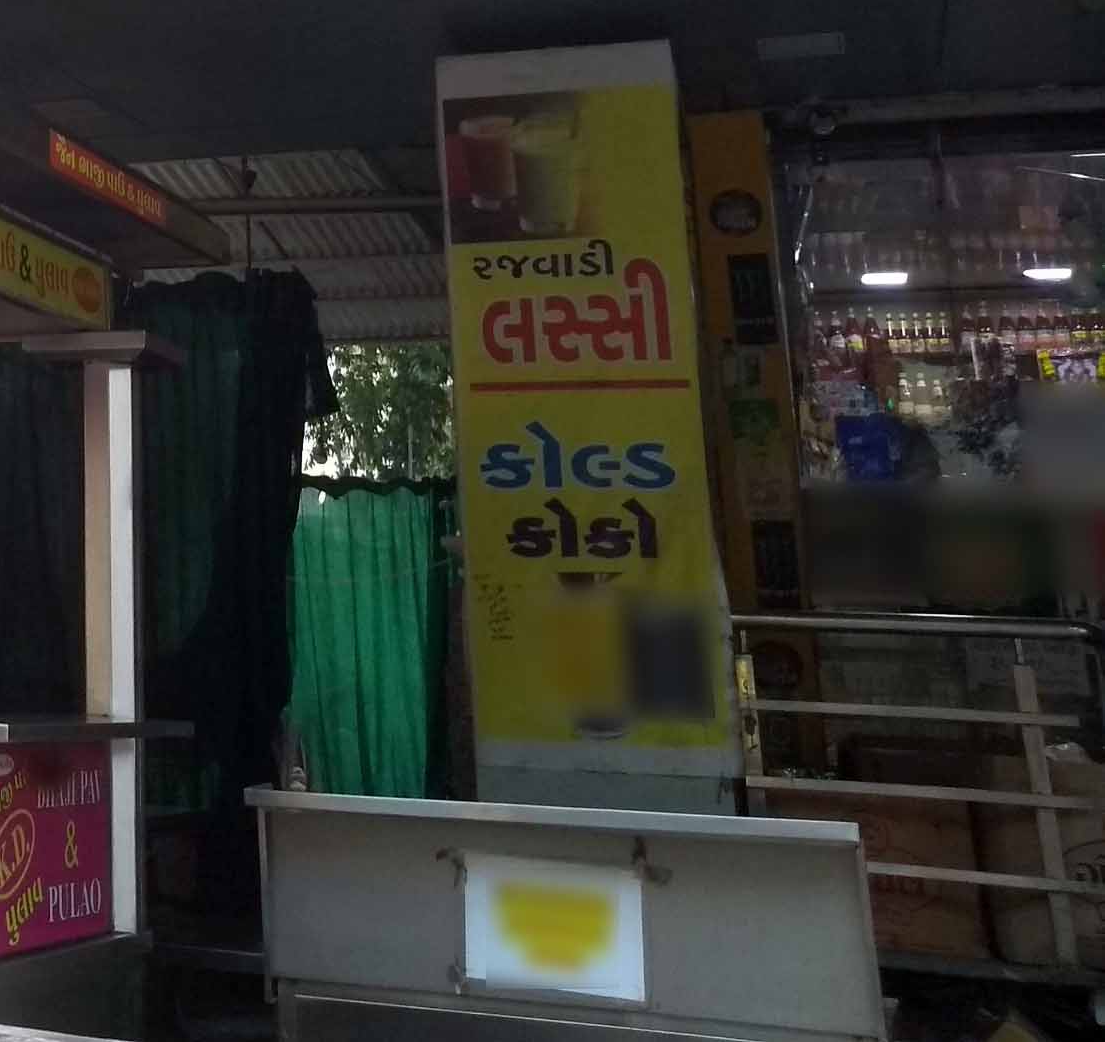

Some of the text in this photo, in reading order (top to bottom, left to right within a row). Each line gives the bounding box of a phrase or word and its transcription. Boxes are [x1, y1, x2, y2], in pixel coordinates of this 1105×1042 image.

[19, 244, 32, 283] &
[473, 239, 614, 279] રજવાડી
[482, 258, 672, 363] લસ્સી
[480, 420, 676, 489] કોલ્ડ
[505, 497, 658, 559] કોકો
[64, 819, 79, 868] &
[48, 876, 103, 924] PULAO
